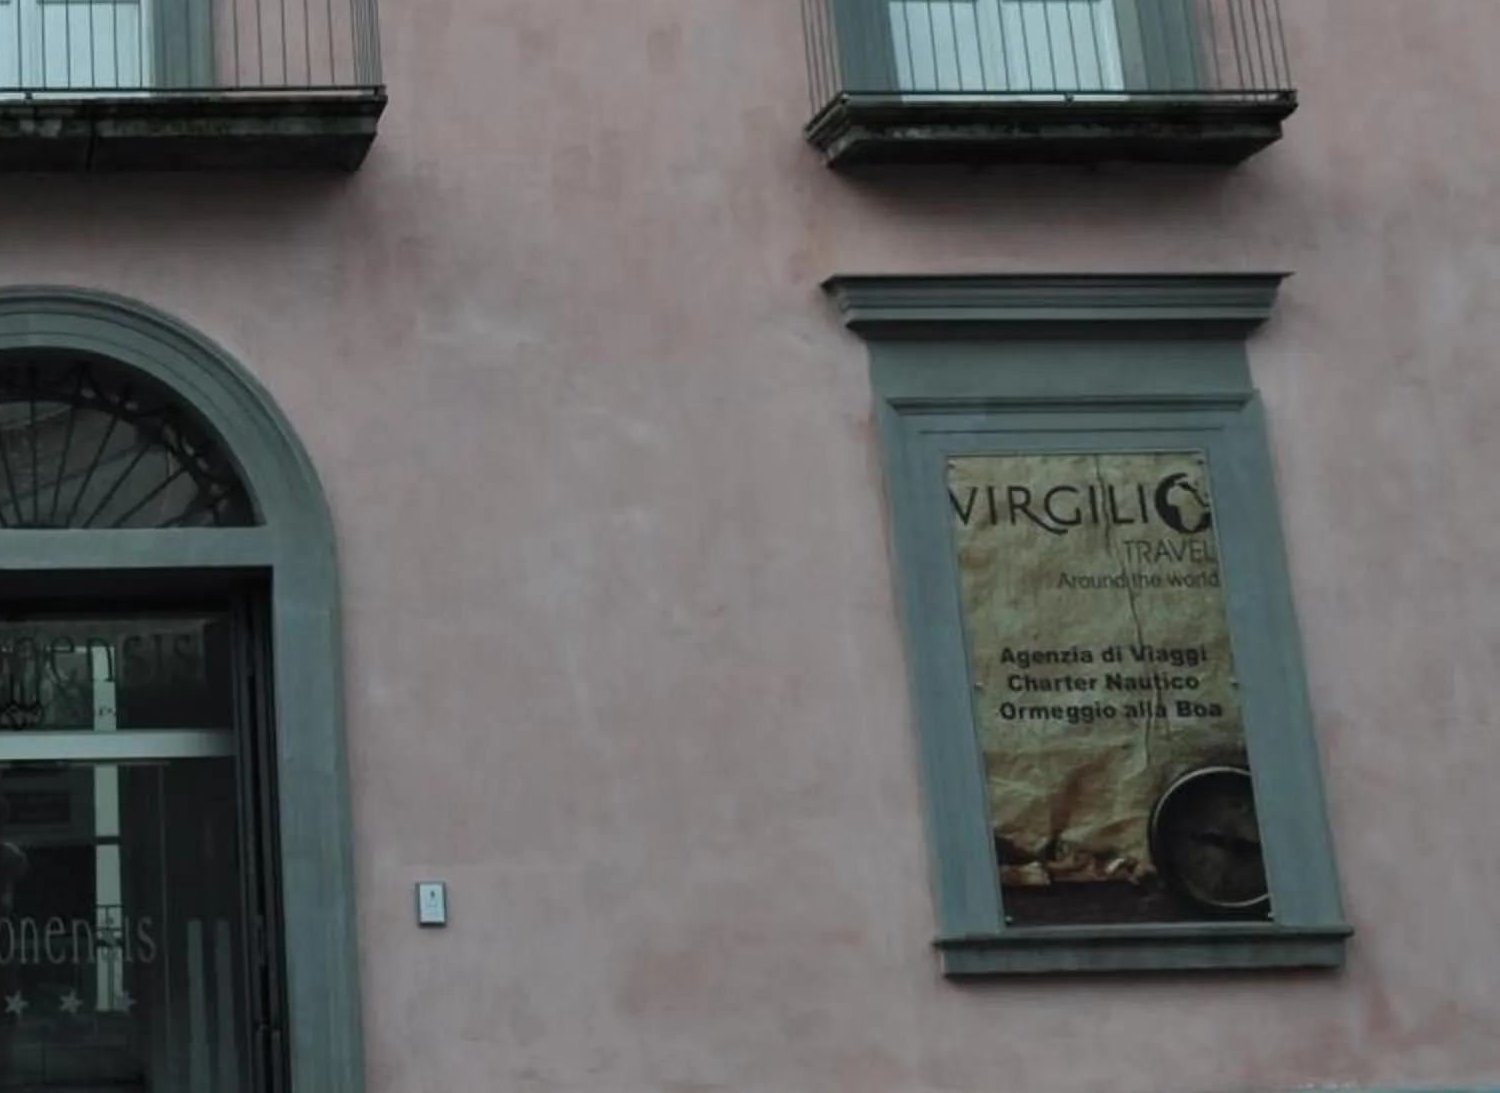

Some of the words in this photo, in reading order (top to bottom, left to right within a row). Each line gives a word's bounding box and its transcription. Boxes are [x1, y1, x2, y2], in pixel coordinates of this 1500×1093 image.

[1123, 538, 1219, 563] TRAVEL
[1056, 571, 1127, 590] Around
[1131, 570, 1162, 589] the
[1166, 570, 1220, 589] world
[1001, 646, 1094, 668] Agenzia
[1100, 645, 1124, 665] di
[1131, 644, 1208, 666] Viaggi
[1007, 673, 1098, 693] Charter
[1105, 672, 1201, 692] Nautico
[1000, 702, 1117, 725] Ormeggio
[1125, 701, 1168, 719] alla
[1176, 700, 1224, 719] Boa
